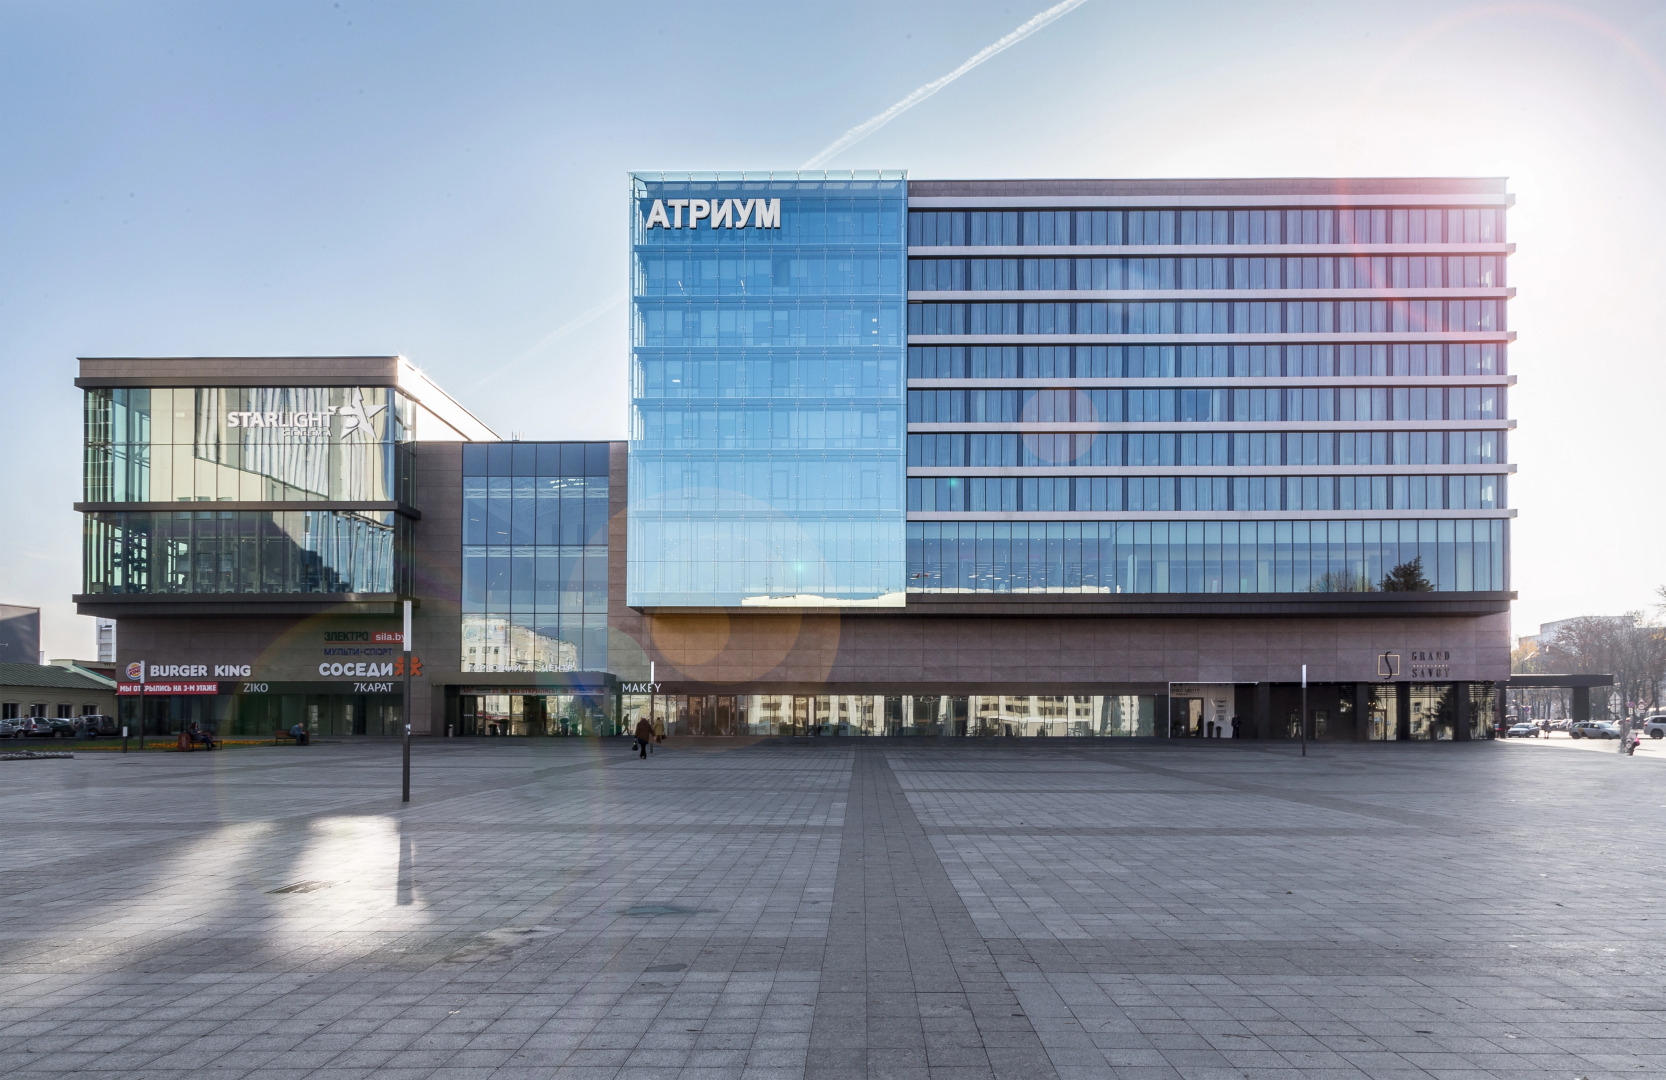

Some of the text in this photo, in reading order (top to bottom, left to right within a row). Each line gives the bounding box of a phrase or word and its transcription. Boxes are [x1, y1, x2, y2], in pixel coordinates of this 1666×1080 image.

[646, 199, 781, 230] АТРИУМ
[227, 411, 337, 428] STARLIGHT
[324, 631, 369, 641] ЭЛЕКТРО
[323, 648, 393, 656] МУЛЬТИ-СПОРТ
[1411, 651, 1450, 661] GRAND
[150, 665, 208, 677] BURGER
[214, 665, 251, 677] KING
[318, 662, 393, 677] СОСЕДИ
[1411, 668, 1450, 678] SAVOY
[243, 683, 269, 693] ZIKO
[622, 683, 662, 693] MAKEY
